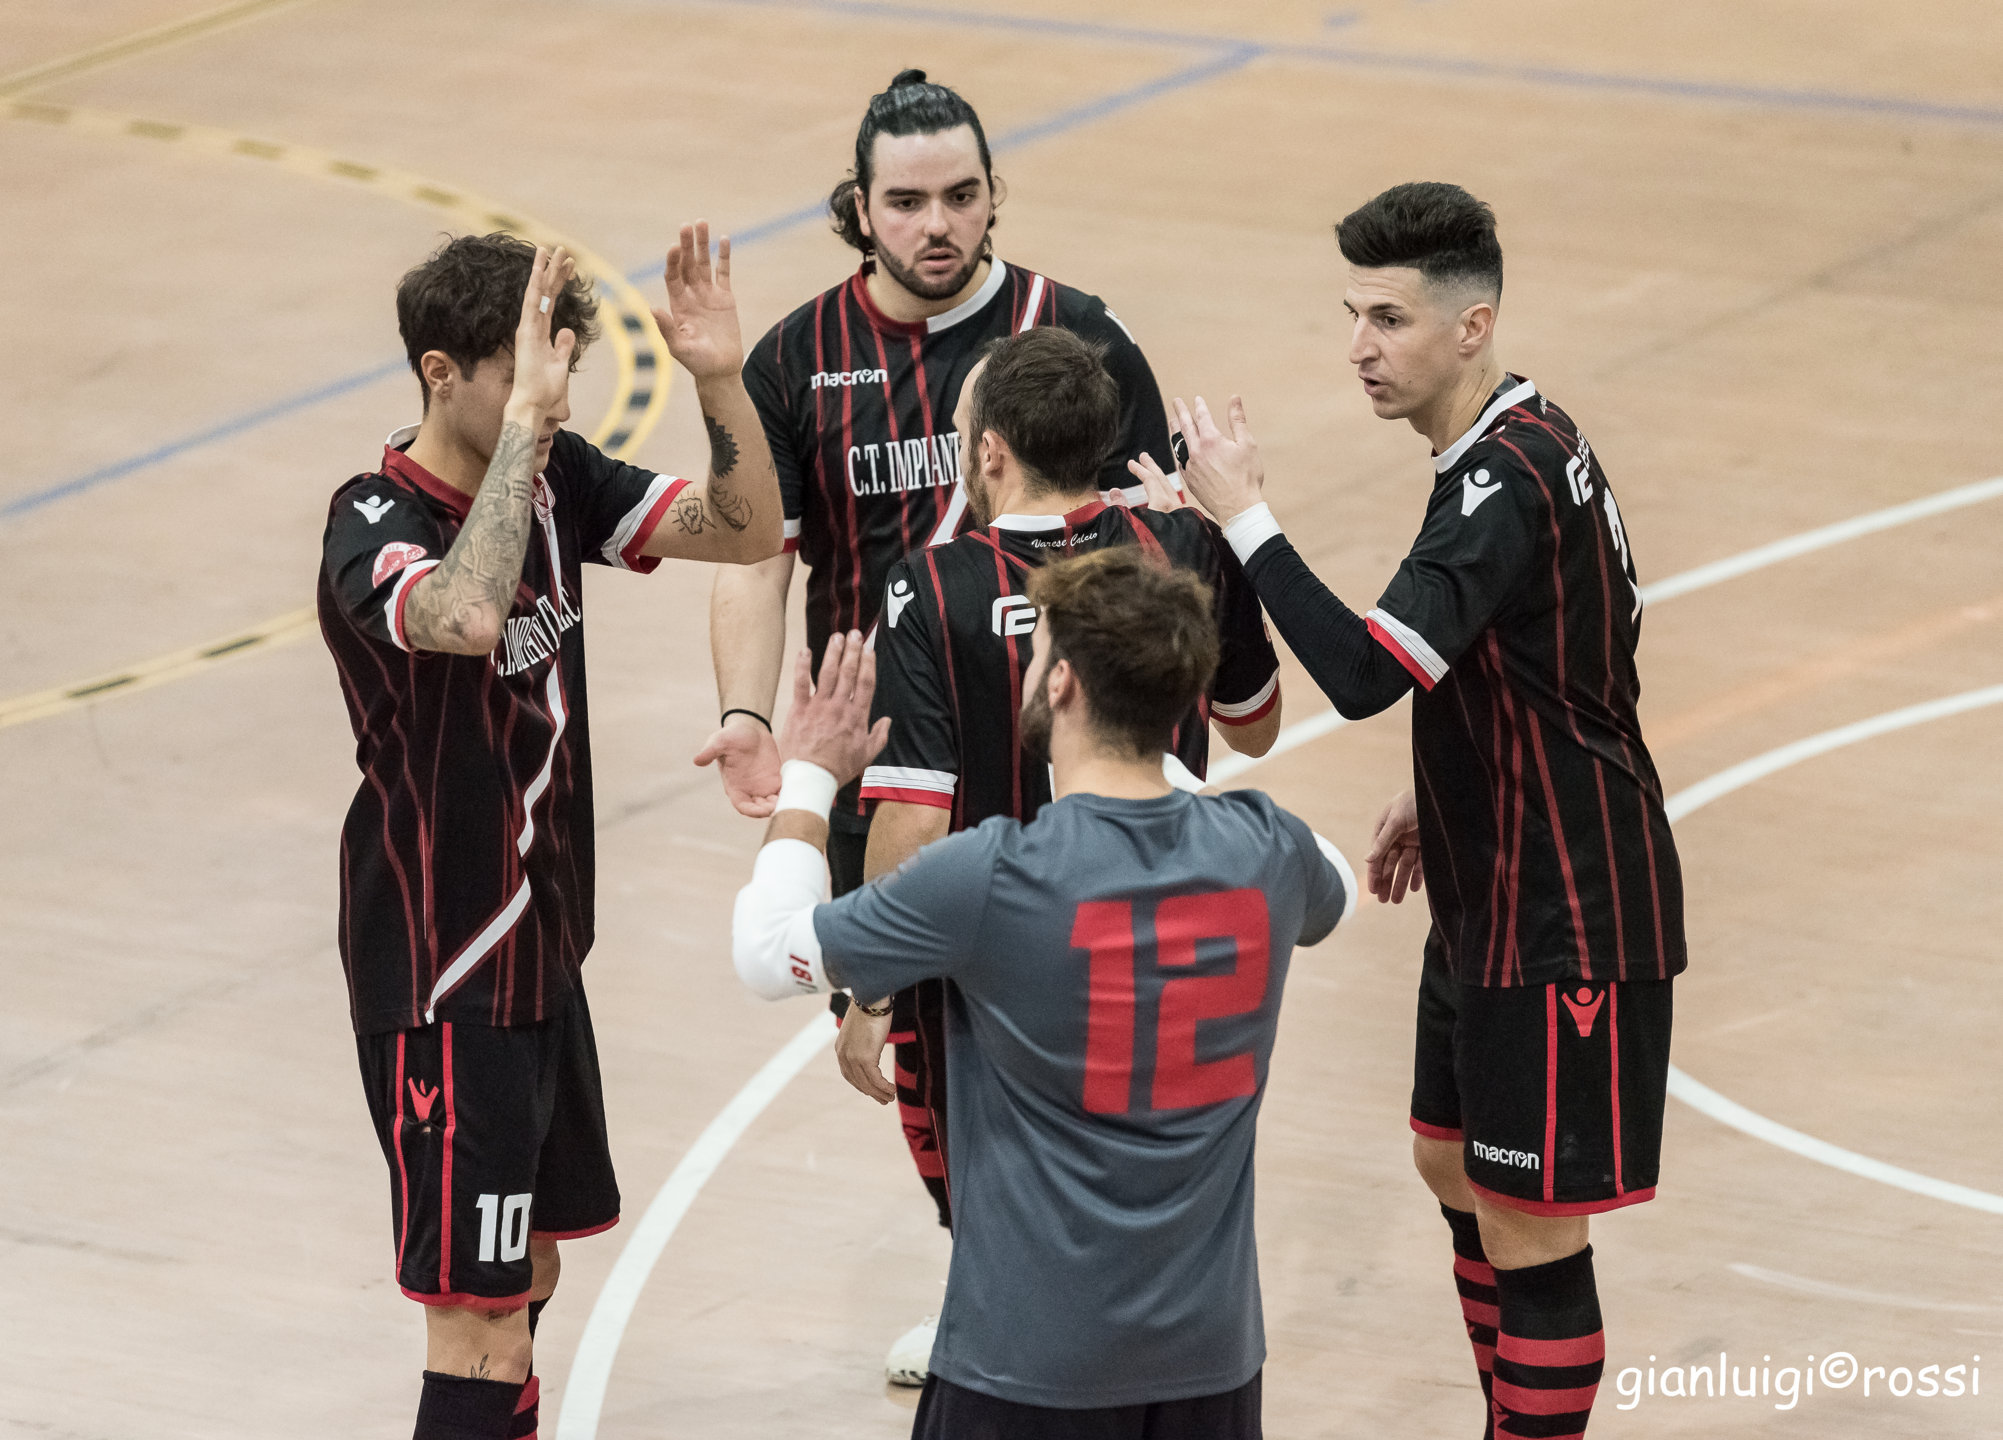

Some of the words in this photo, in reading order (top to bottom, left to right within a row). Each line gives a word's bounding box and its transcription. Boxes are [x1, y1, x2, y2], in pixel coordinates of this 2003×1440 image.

[810, 368, 888, 390] macron
[847, 443, 887, 497] C.T.
[1031, 538, 1067, 548] Varese
[1070, 532, 1098, 547] Calcio
[1070, 887, 1271, 1115] 12
[1473, 1140, 1540, 1170] macron
[475, 1192, 533, 1263] 10
